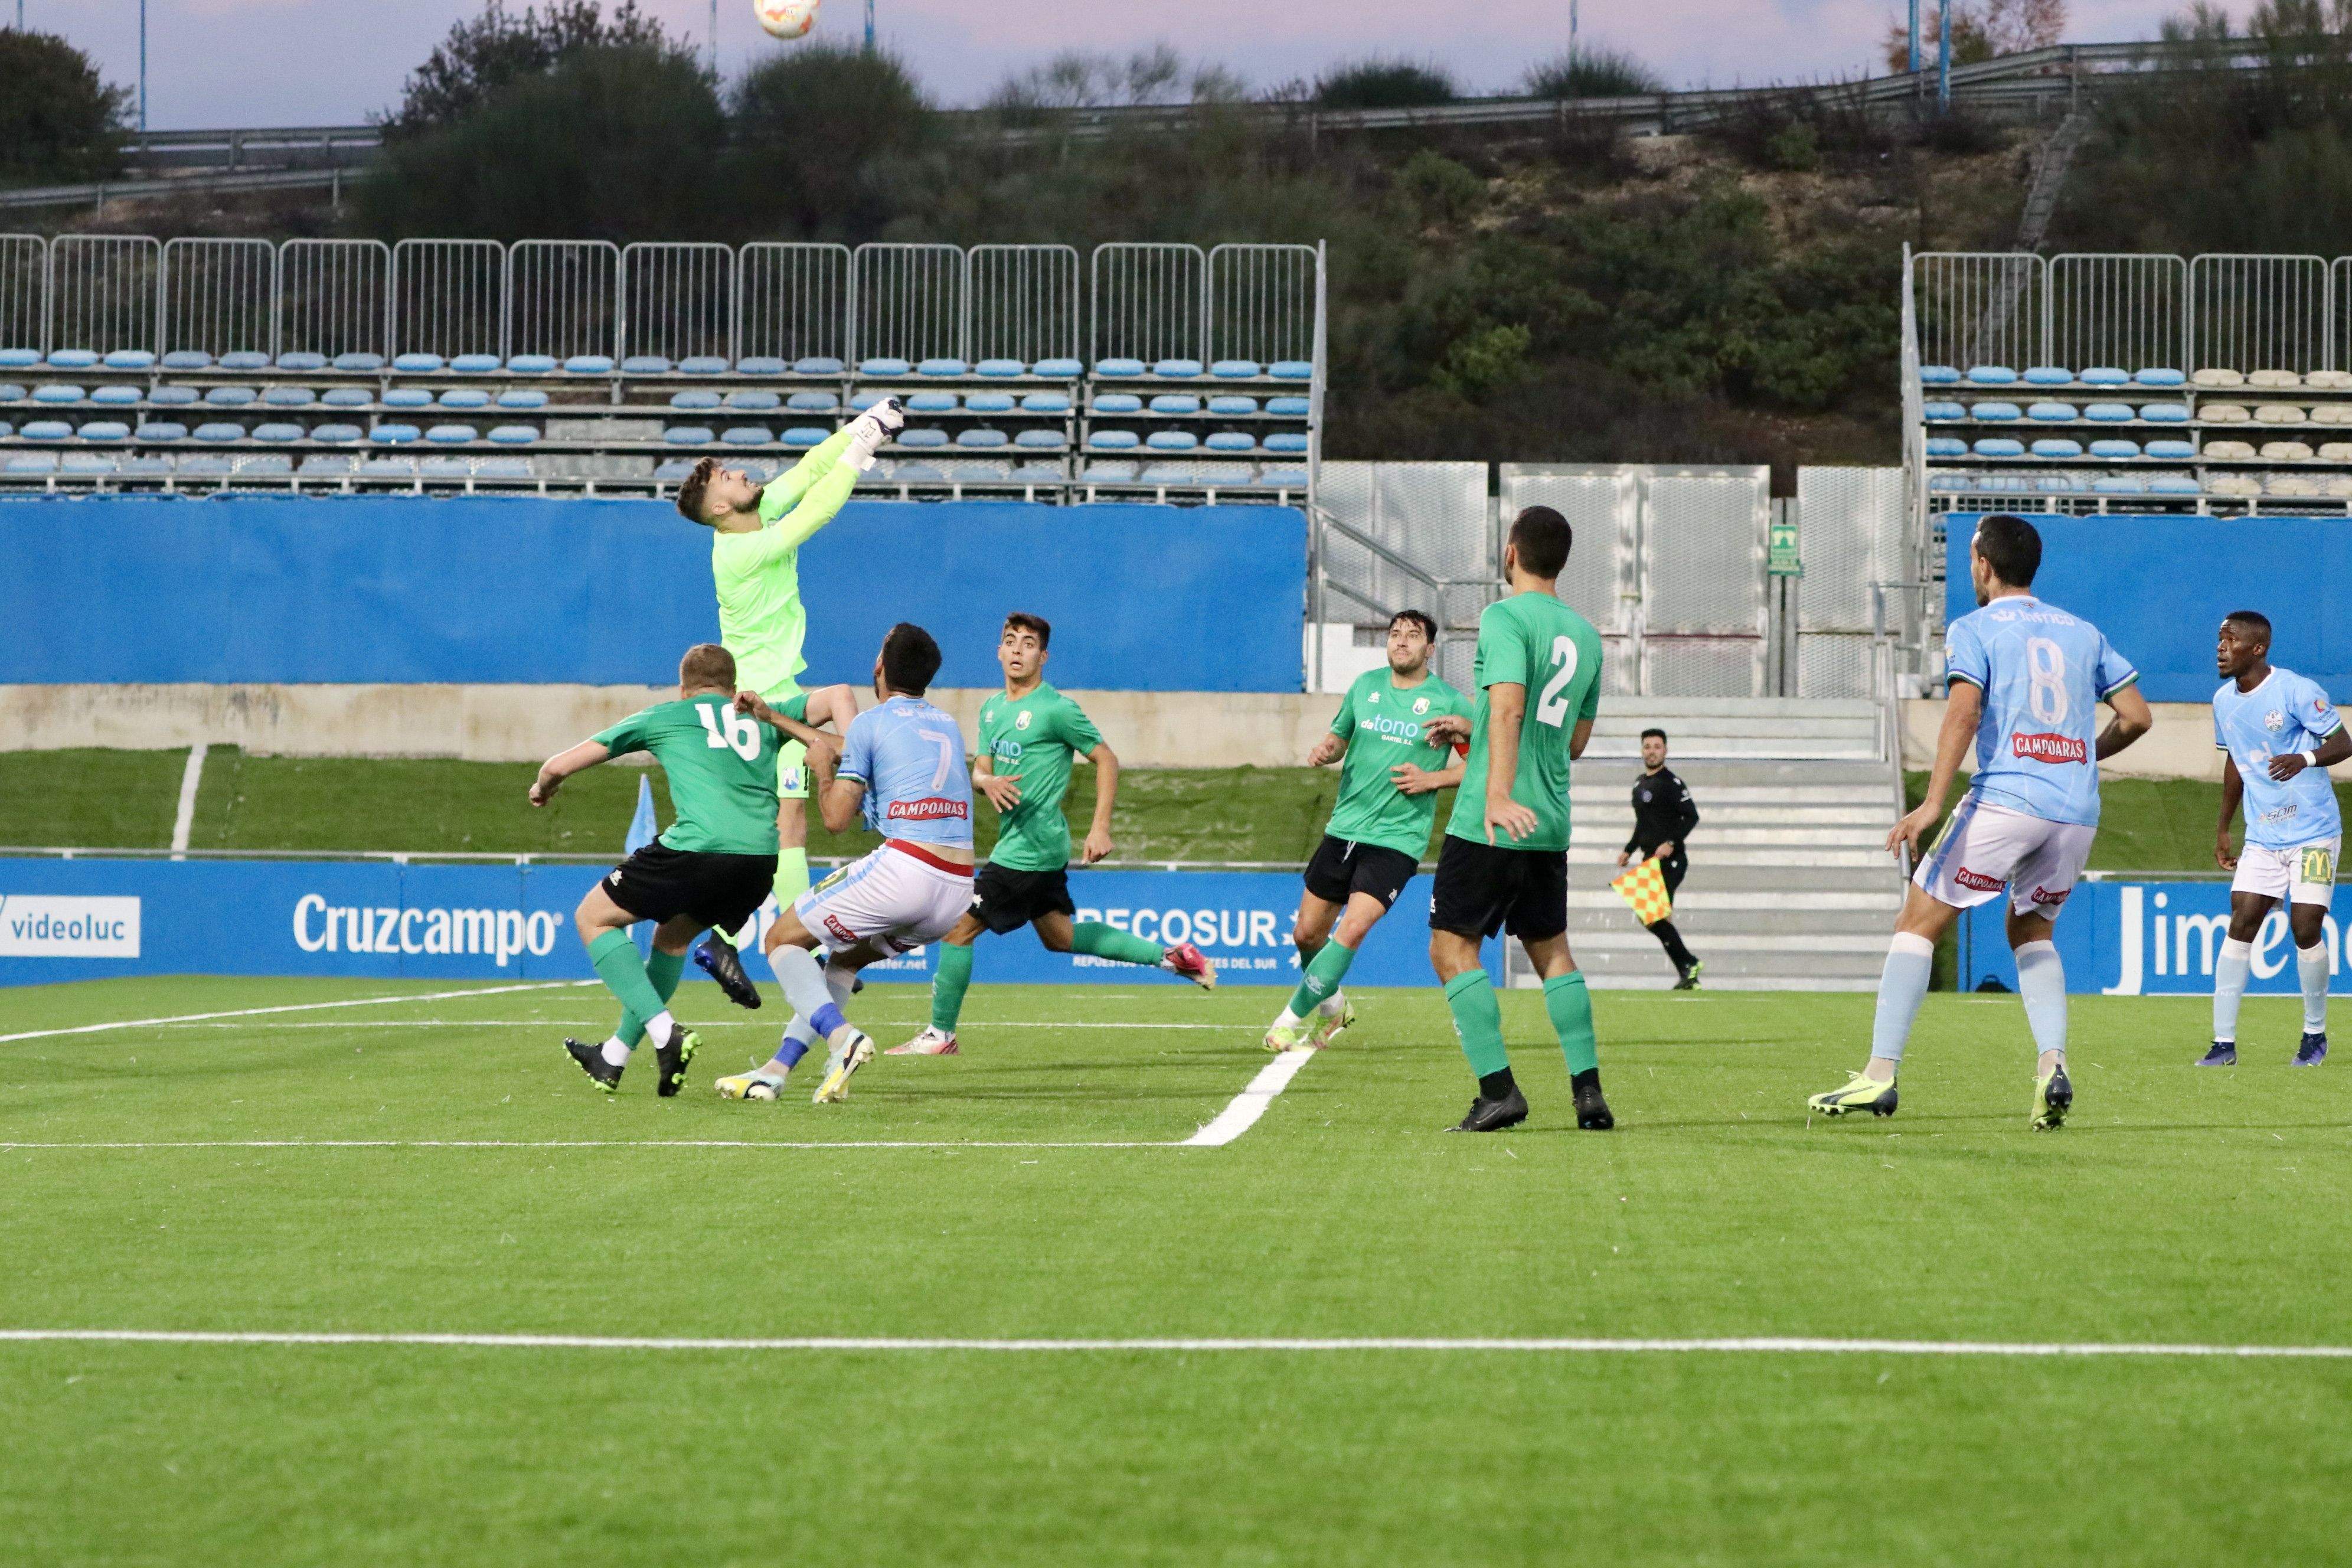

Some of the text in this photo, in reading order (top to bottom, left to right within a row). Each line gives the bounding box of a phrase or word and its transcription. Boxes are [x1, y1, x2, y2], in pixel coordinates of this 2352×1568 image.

[1536, 635, 1577, 728] 2
[2026, 636, 2067, 725] 8
[694, 703, 760, 761] 16
[1361, 714, 1418, 737] datono
[919, 729, 953, 791] 7
[2015, 737, 2083, 758] CAMPOARAS
[890, 802, 964, 816] CAMPOARAS
[11, 913, 125, 940] videoluc
[294, 893, 556, 966] Cruzcampo
[1230, 958, 1251, 969] DEL
[1254, 958, 1277, 969] SUR
